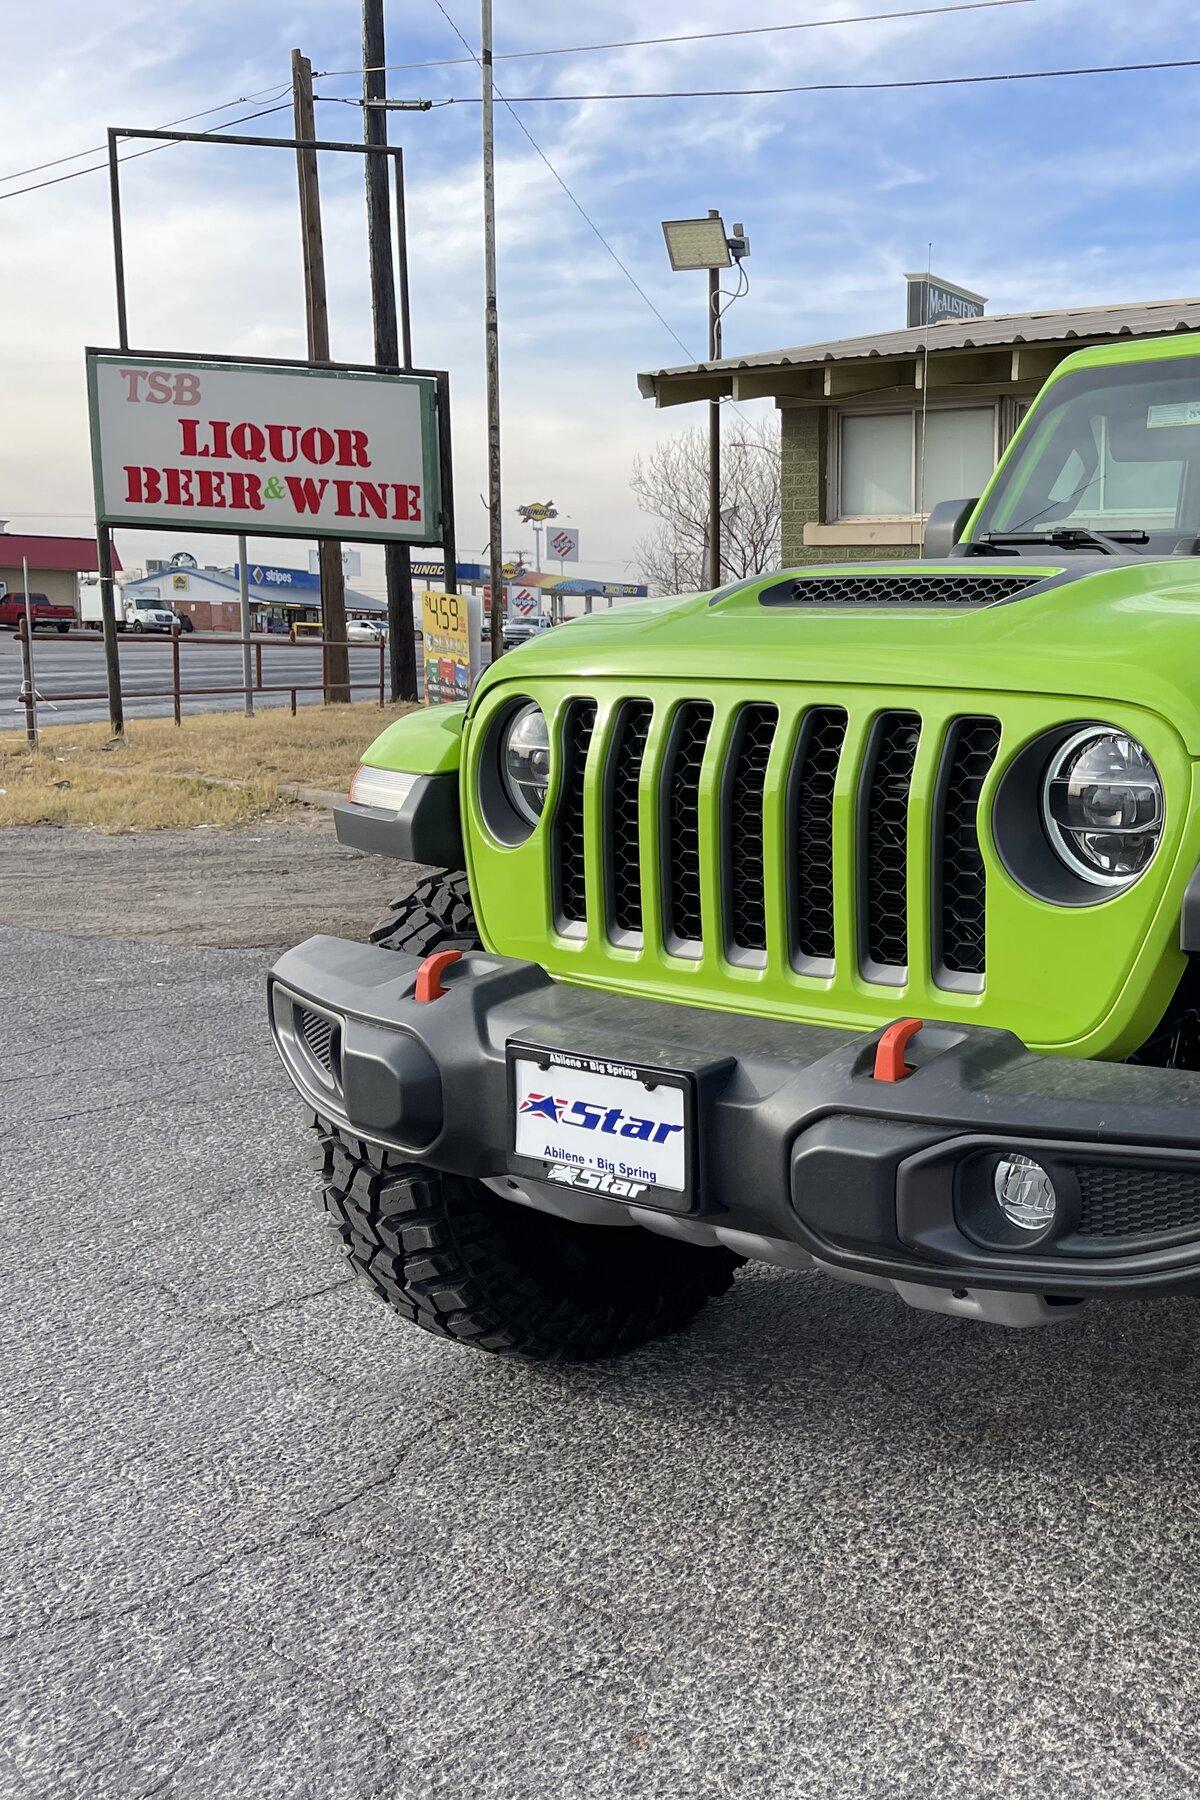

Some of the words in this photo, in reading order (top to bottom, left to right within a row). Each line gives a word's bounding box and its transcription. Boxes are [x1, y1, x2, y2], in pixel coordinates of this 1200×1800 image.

[119, 368, 203, 406] TSB
[177, 418, 372, 468] LIQUOR
[265, 569, 292, 584] stripes
[410, 564, 445, 575] SUNOC
[550, 1053, 582, 1068] Abilene
[590, 1060, 605, 1074] Big
[607, 1063, 638, 1080] Spring
[562, 1100, 685, 1144] Star
[544, 1145, 585, 1165] Abilene
[597, 1157, 615, 1175] Big
[619, 1163, 657, 1183] Spring
[573, 1168, 648, 1198] Star
